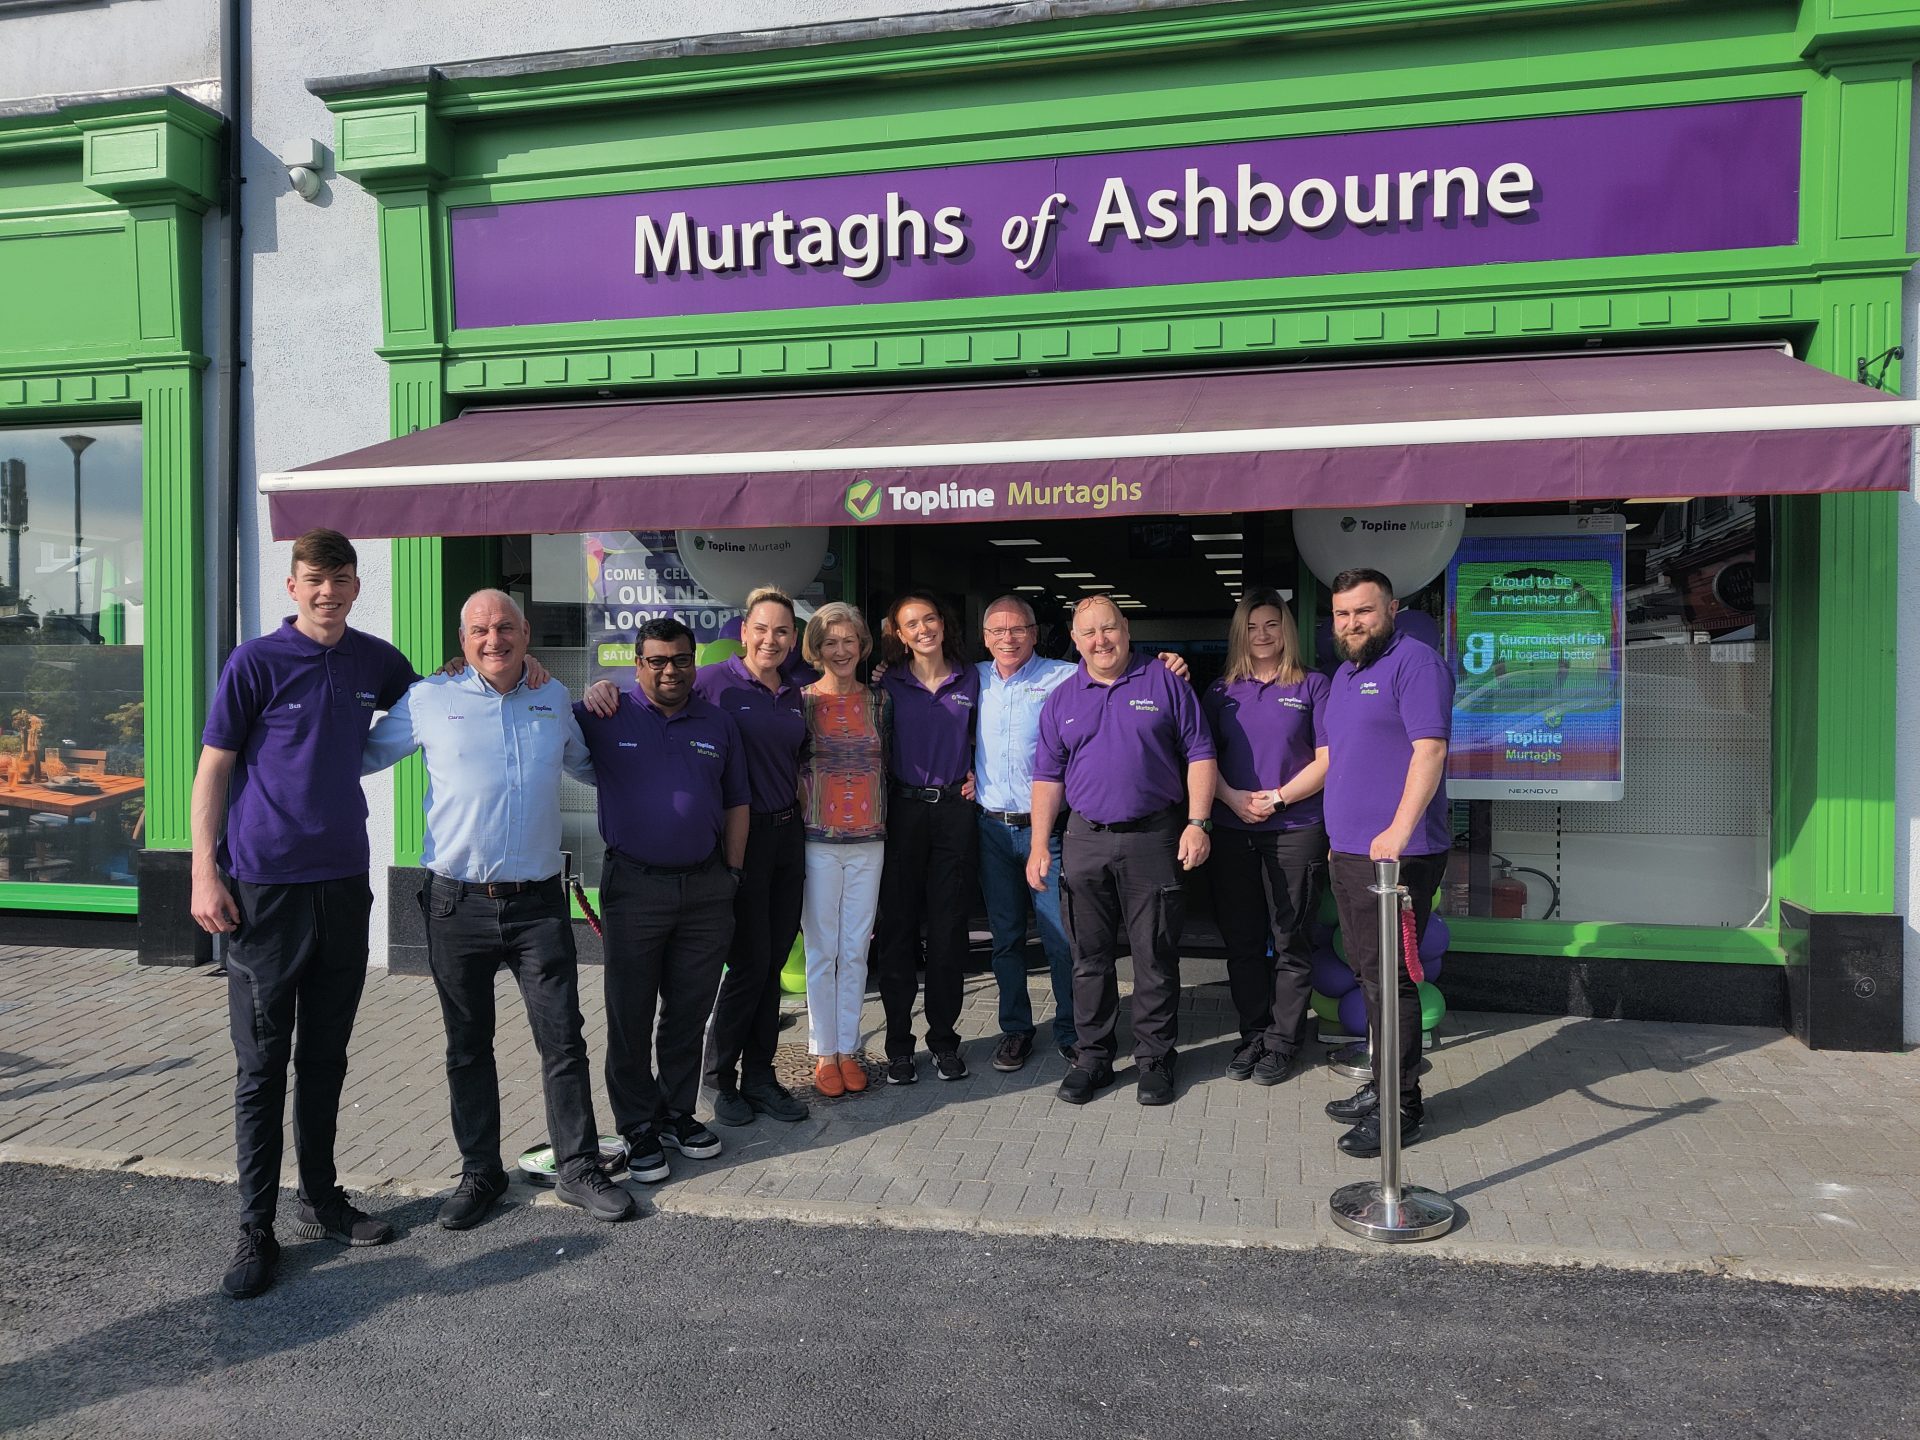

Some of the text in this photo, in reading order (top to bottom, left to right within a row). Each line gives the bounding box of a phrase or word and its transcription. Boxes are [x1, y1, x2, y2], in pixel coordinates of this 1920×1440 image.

[634, 160, 1534, 279] Murtaghs of Ashbourne
[888, 476, 1143, 516] Topline Murtaghs
[1361, 520, 1407, 533] Topline
[707, 540, 746, 552] Topline
[604, 568, 645, 581] COME
[648, 568, 659, 580] &
[1493, 574, 1572, 587] Proud to be
[618, 585, 668, 605] OUR
[1501, 593, 1561, 604] member
[1564, 591, 1578, 604] of
[673, 609, 741, 629] STOR
[1499, 633, 1605, 645] Guaranteed Irish
[1499, 648, 1596, 662] All together better
[1505, 729, 1562, 746] Topline
[1506, 750, 1562, 763] Murtaghs
